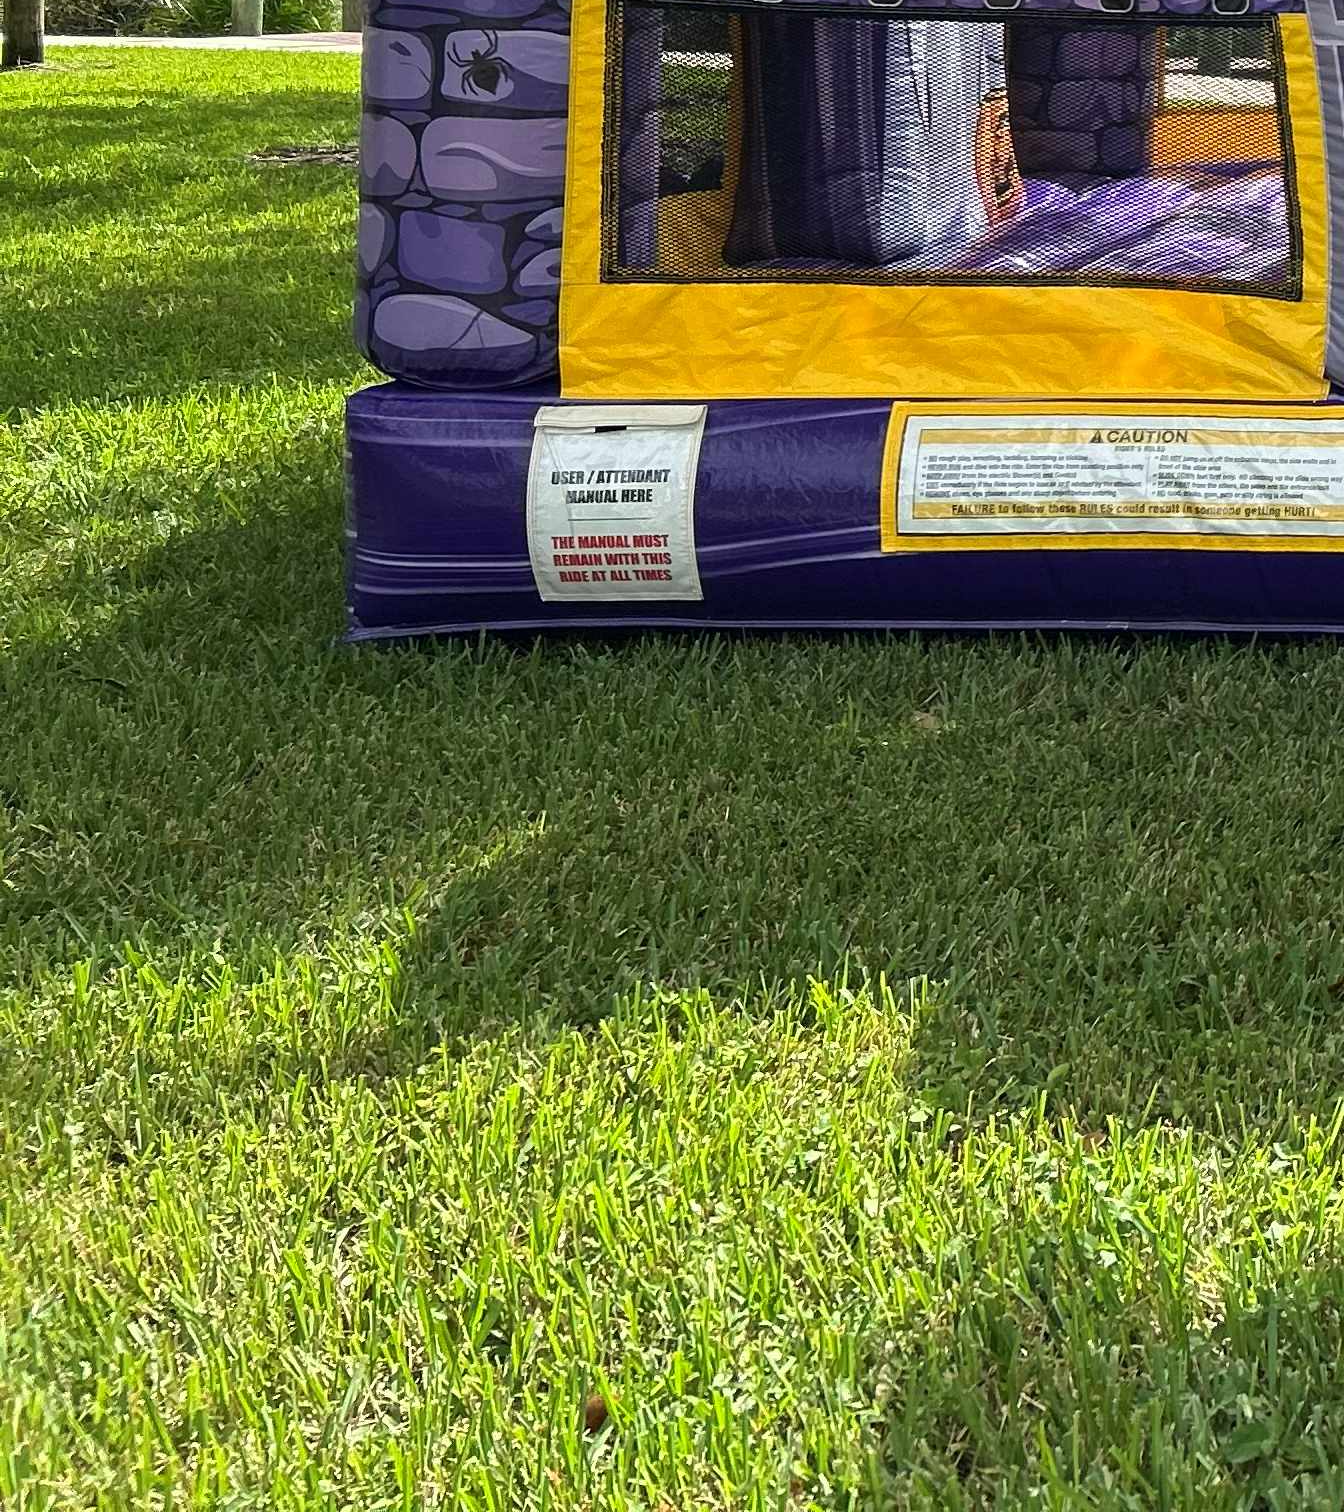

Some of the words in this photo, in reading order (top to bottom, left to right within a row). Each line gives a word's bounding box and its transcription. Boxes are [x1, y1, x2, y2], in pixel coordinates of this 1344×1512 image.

[1106, 430, 1188, 444] CAUTION
[551, 471, 585, 485] USER
[587, 470, 595, 484] /
[596, 469, 671, 484] ATTENDANT
[566, 489, 618, 504] MANUAL
[621, 489, 653, 503] HERE
[951, 504, 995, 515] FAILURE
[998, 504, 1009, 513] to
[1012, 504, 1045, 514] follow
[1048, 504, 1077, 514] these
[1079, 504, 1114, 515] RULES
[1116, 504, 1145, 514] could
[1148, 504, 1180, 514] result
[1183, 504, 1193, 514] in
[1194, 506, 1242, 516] someone
[1244, 506, 1281, 518] getting
[551, 536, 575, 549] THE
[578, 535, 630, 548] MANUAL
[632, 534, 669, 548] MUST
[553, 554, 602, 566] REMAIN
[604, 553, 640, 565] WITH
[642, 552, 672, 565] THIS
[559, 571, 589, 582] RIDE
[591, 570, 607, 581] AT
[610, 570, 632, 581] ALL
[632, 569, 673, 581] TIMES
